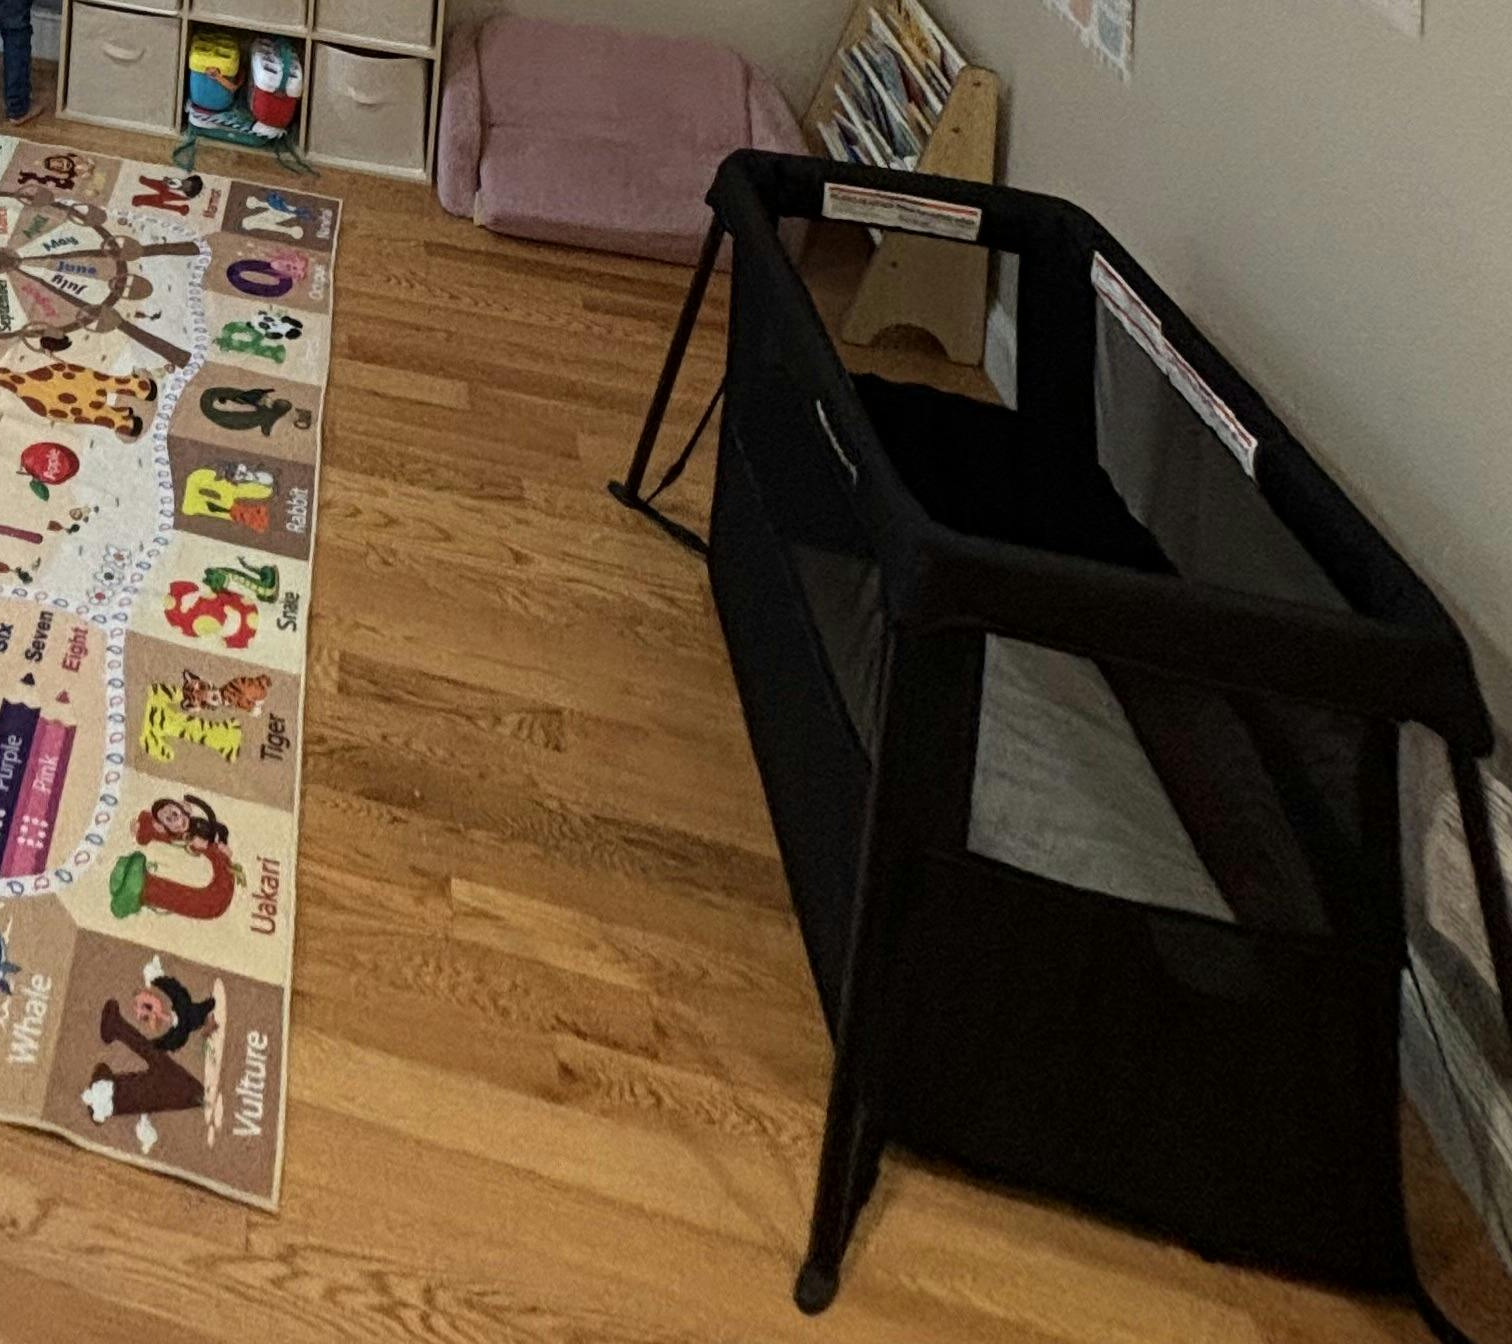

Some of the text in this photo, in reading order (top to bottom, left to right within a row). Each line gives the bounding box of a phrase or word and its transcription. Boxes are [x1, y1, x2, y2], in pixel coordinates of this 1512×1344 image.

[131, 174, 191, 217] M
[241, 195, 304, 240] N
[42, 235, 80, 253] May
[55, 260, 97, 276] June
[50, 273, 89, 296] July
[226, 259, 294, 298] O
[213, 320, 287, 365] P
[199, 386, 292, 437] Q
[181, 468, 274, 534] R
[285, 486, 309, 534] Rabbit
[163, 579, 260, 649] S
[276, 591, 301, 633] Snake
[24, 610, 54, 664] Seven
[61, 625, 88, 673] Eight
[140, 682, 242, 762] T
[259, 713, 292, 762] Tiger
[32, 753, 60, 794] Pink
[249, 855, 282, 937] Uakari
[8, 971, 54, 1065] Whale
[92, 999, 207, 1115] V
[232, 1028, 270, 1139] Vulture
